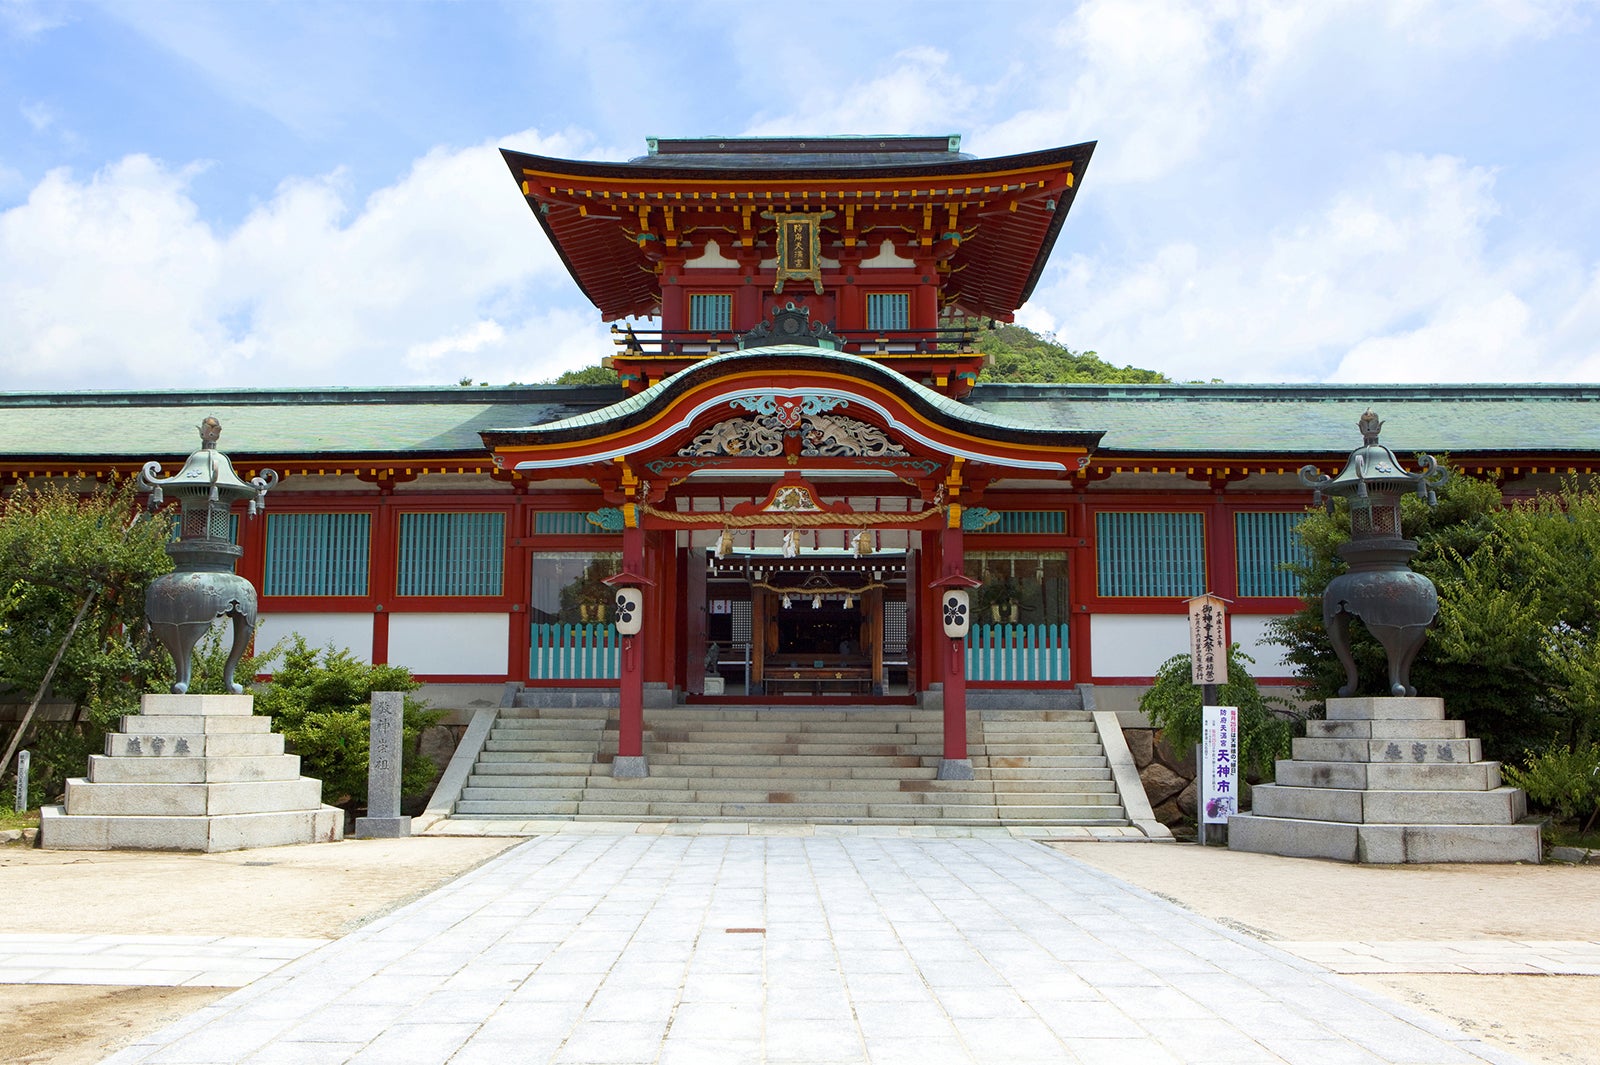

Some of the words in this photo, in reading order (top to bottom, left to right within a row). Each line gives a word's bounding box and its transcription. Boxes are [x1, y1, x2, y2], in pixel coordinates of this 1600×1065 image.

[1219, 709, 1227, 747] 防府天満宮
[1217, 749, 1230, 793] 天神市
